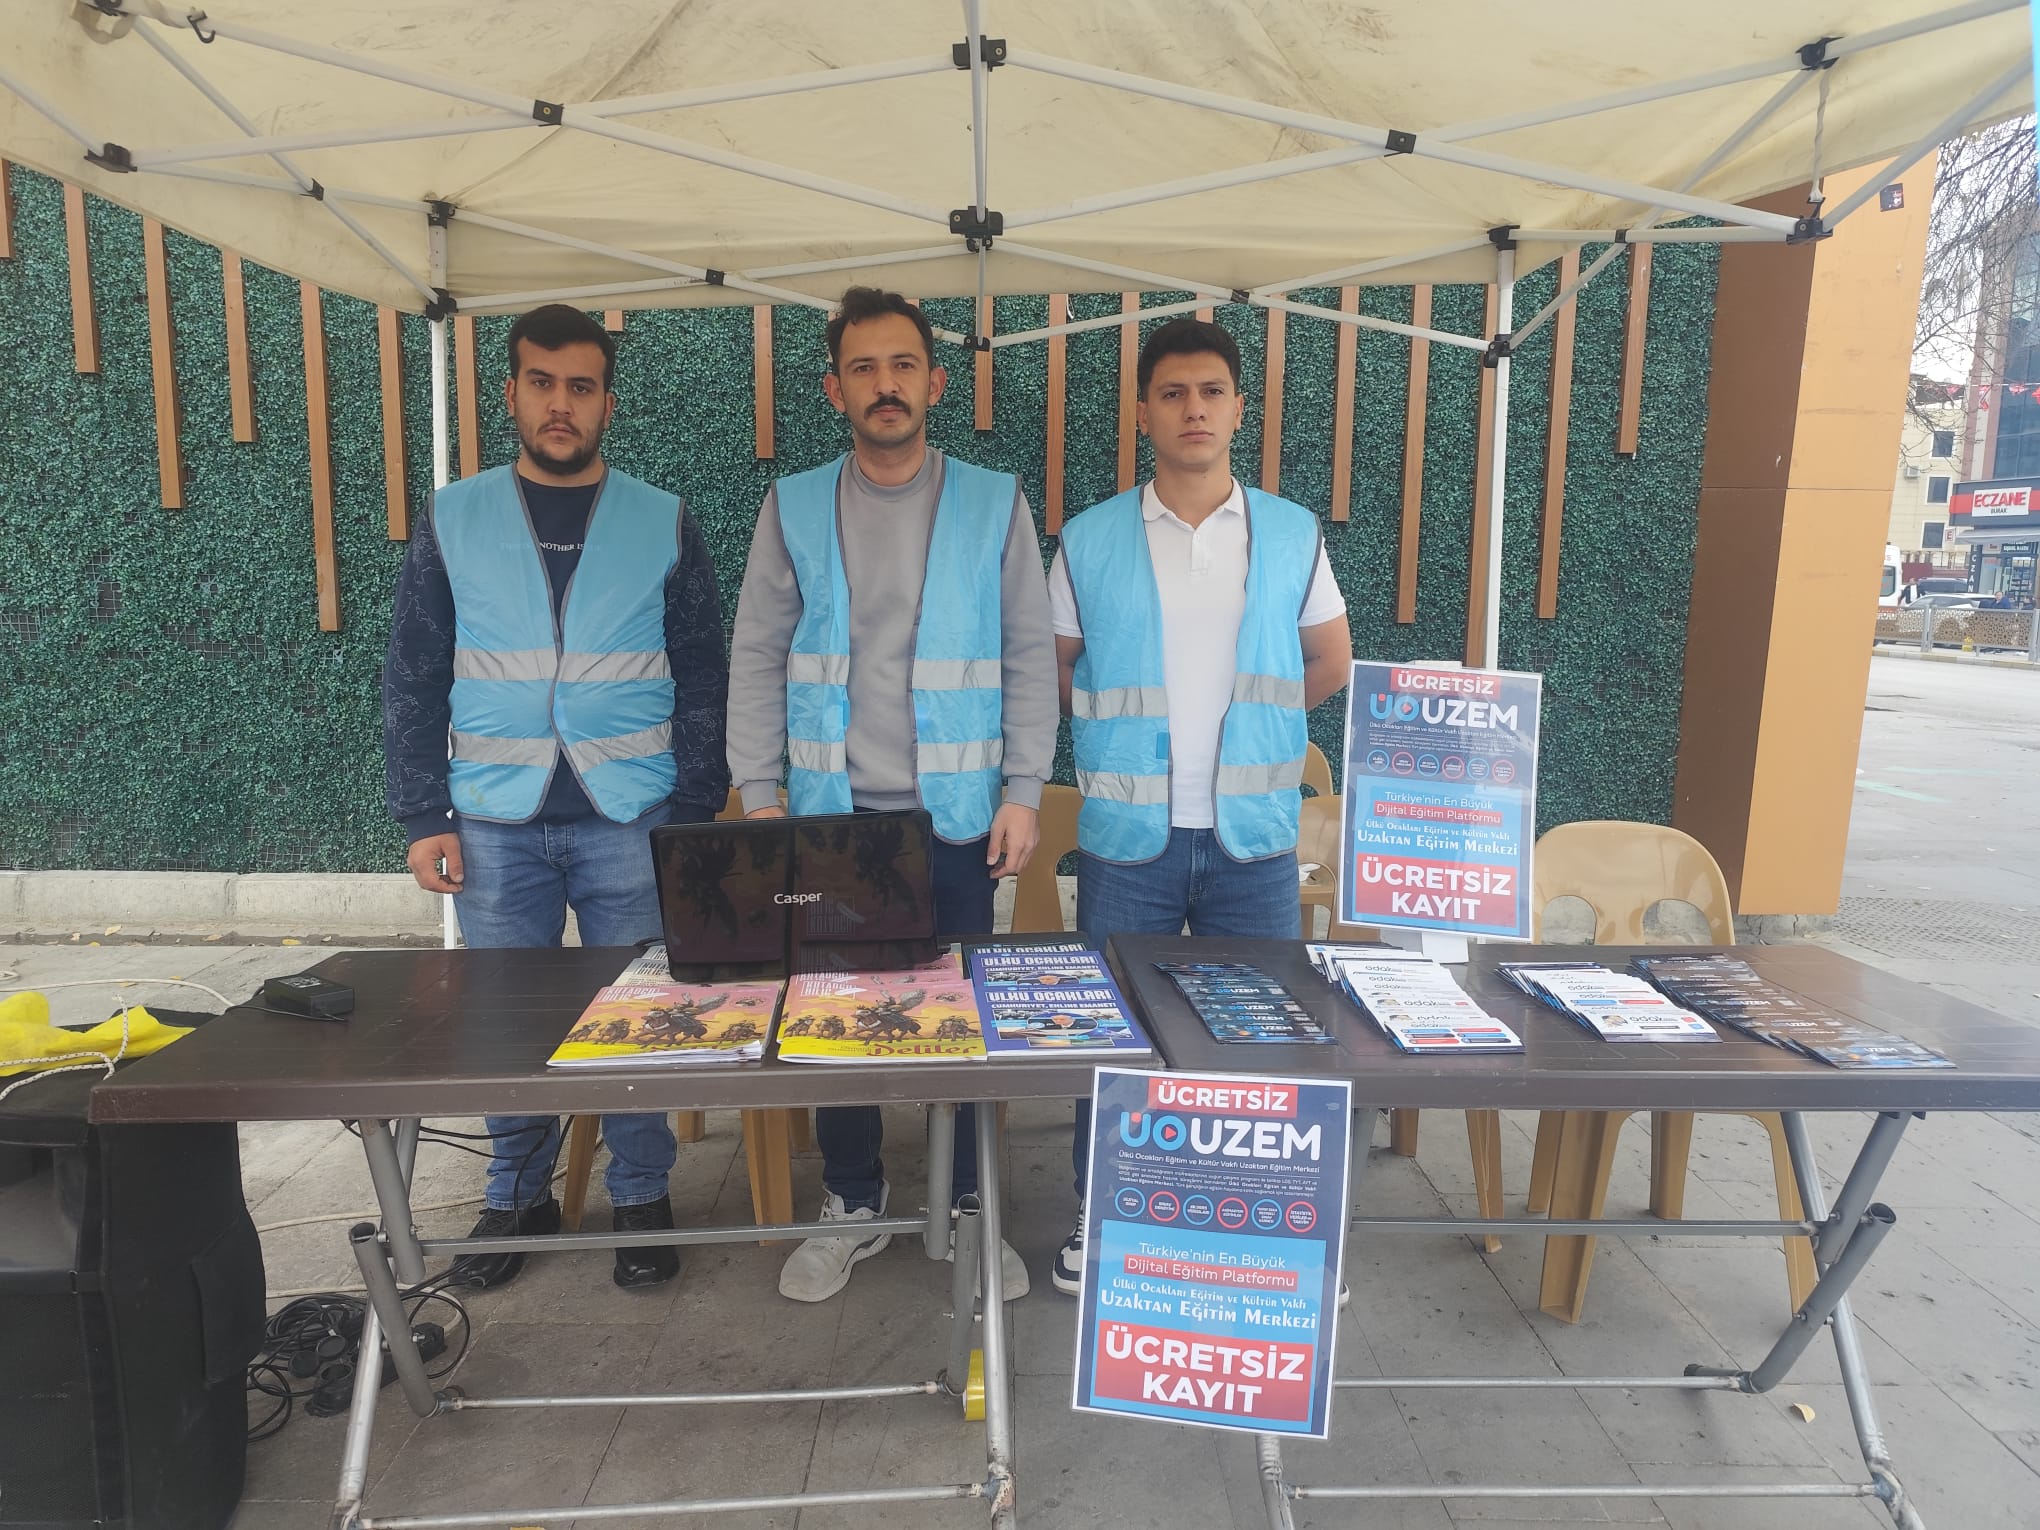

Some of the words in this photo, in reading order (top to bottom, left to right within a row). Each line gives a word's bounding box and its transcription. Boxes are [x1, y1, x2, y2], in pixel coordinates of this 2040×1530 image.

[1974, 491, 2026, 507] ECZANE
[540, 542, 574, 552] NOTHER
[1968, 544, 1977, 592] ECZAN
[1397, 670, 1494, 695] ÜCRETSİZ
[1376, 803, 1407, 817] Dijital
[1410, 806, 1444, 819] Eğitim
[1447, 810, 1500, 824] Platformu
[1385, 791, 1440, 806] Türkiye'nin
[1444, 797, 1458, 806] En
[1460, 798, 1494, 810] Büyük
[1362, 856, 1512, 896] ÜCRETSİZ
[774, 892, 822, 906] Casper
[1391, 891, 1480, 920] KAYIT
[866, 1044, 978, 1056] Deliler
[1158, 1080, 1288, 1112] ÜCRETSİZ
[1118, 1150, 1134, 1158] Ülkü
[1166, 1156, 1188, 1164] Eğitim
[1198, 1158, 1220, 1166] Kültür
[1240, 1162, 1268, 1170] Uzaktan
[1270, 1164, 1292, 1172] Eğitim
[1139, 1242, 1214, 1263] Türkiye'nin
[1219, 1253, 1236, 1265] En
[1242, 1254, 1286, 1269] Büyük
[1128, 1258, 1168, 1274] Dijital
[1172, 1264, 1218, 1280] Eğitim
[1222, 1269, 1294, 1287] Platformu
[1105, 1324, 1304, 1382] ÜCRETSİZ
[1142, 1372, 1262, 1413] KAYIT
